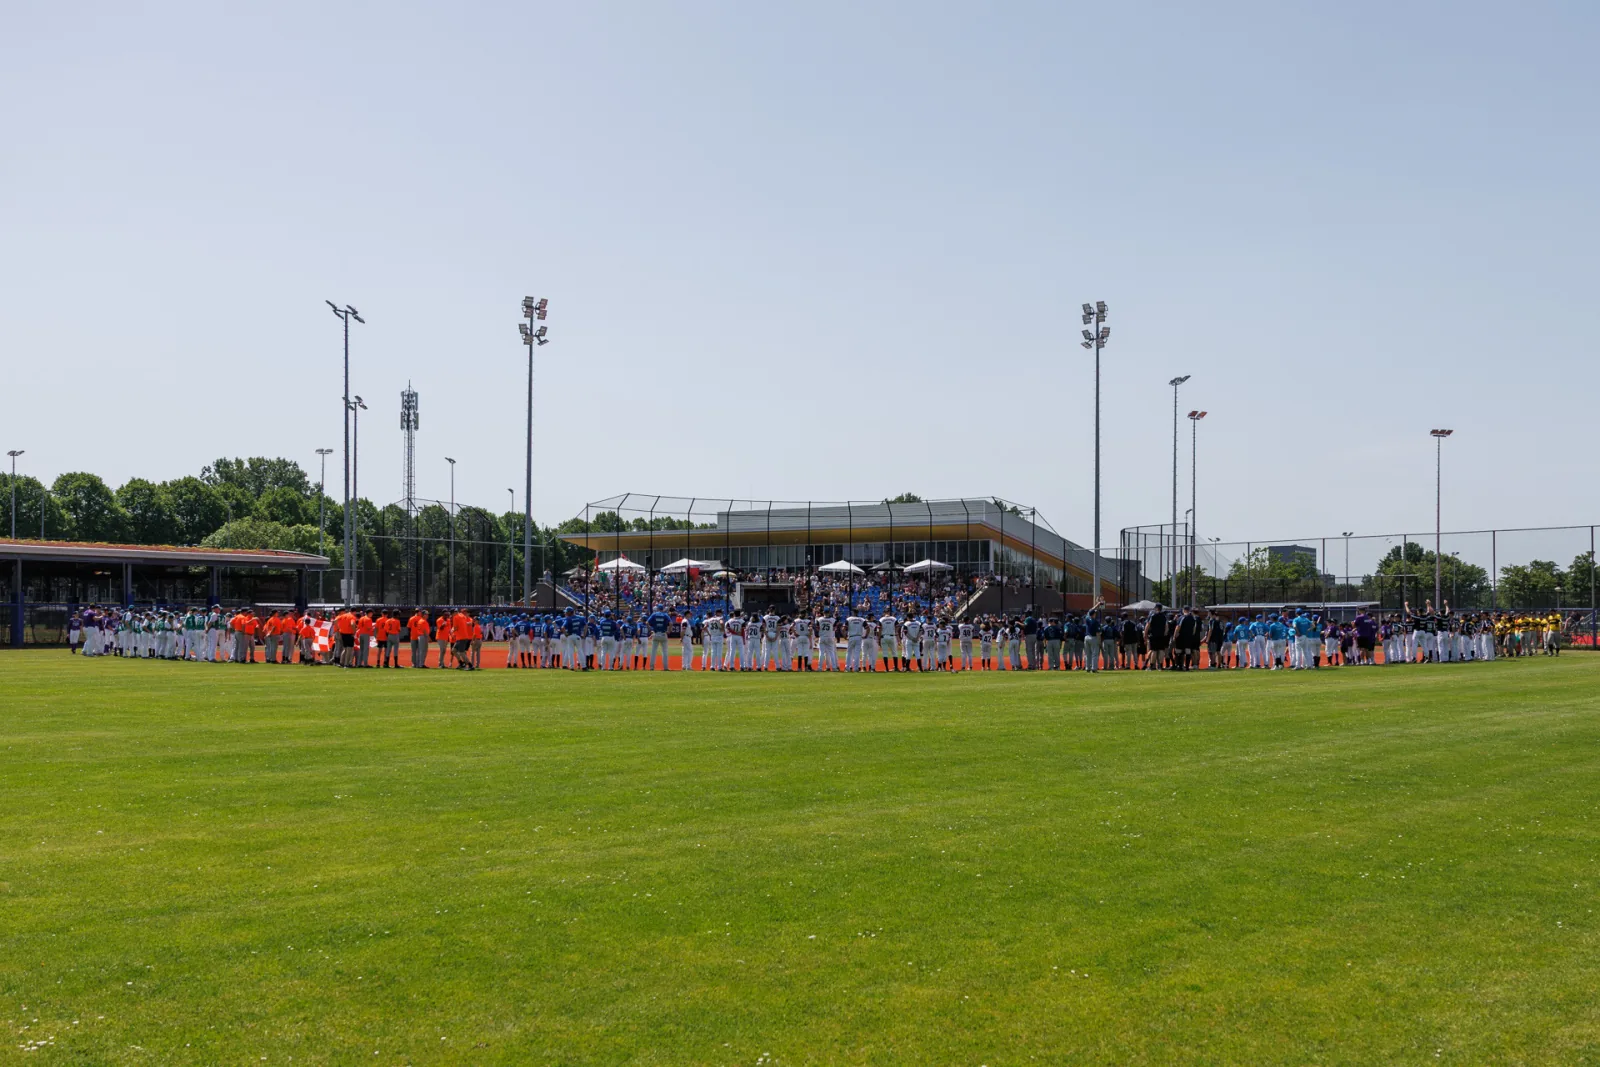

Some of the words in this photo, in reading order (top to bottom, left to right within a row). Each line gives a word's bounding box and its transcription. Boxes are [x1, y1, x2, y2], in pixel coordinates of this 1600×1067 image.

[768, 620, 775, 628] 31
[750, 628, 757, 636] 20
[984, 635, 992, 643] 42
